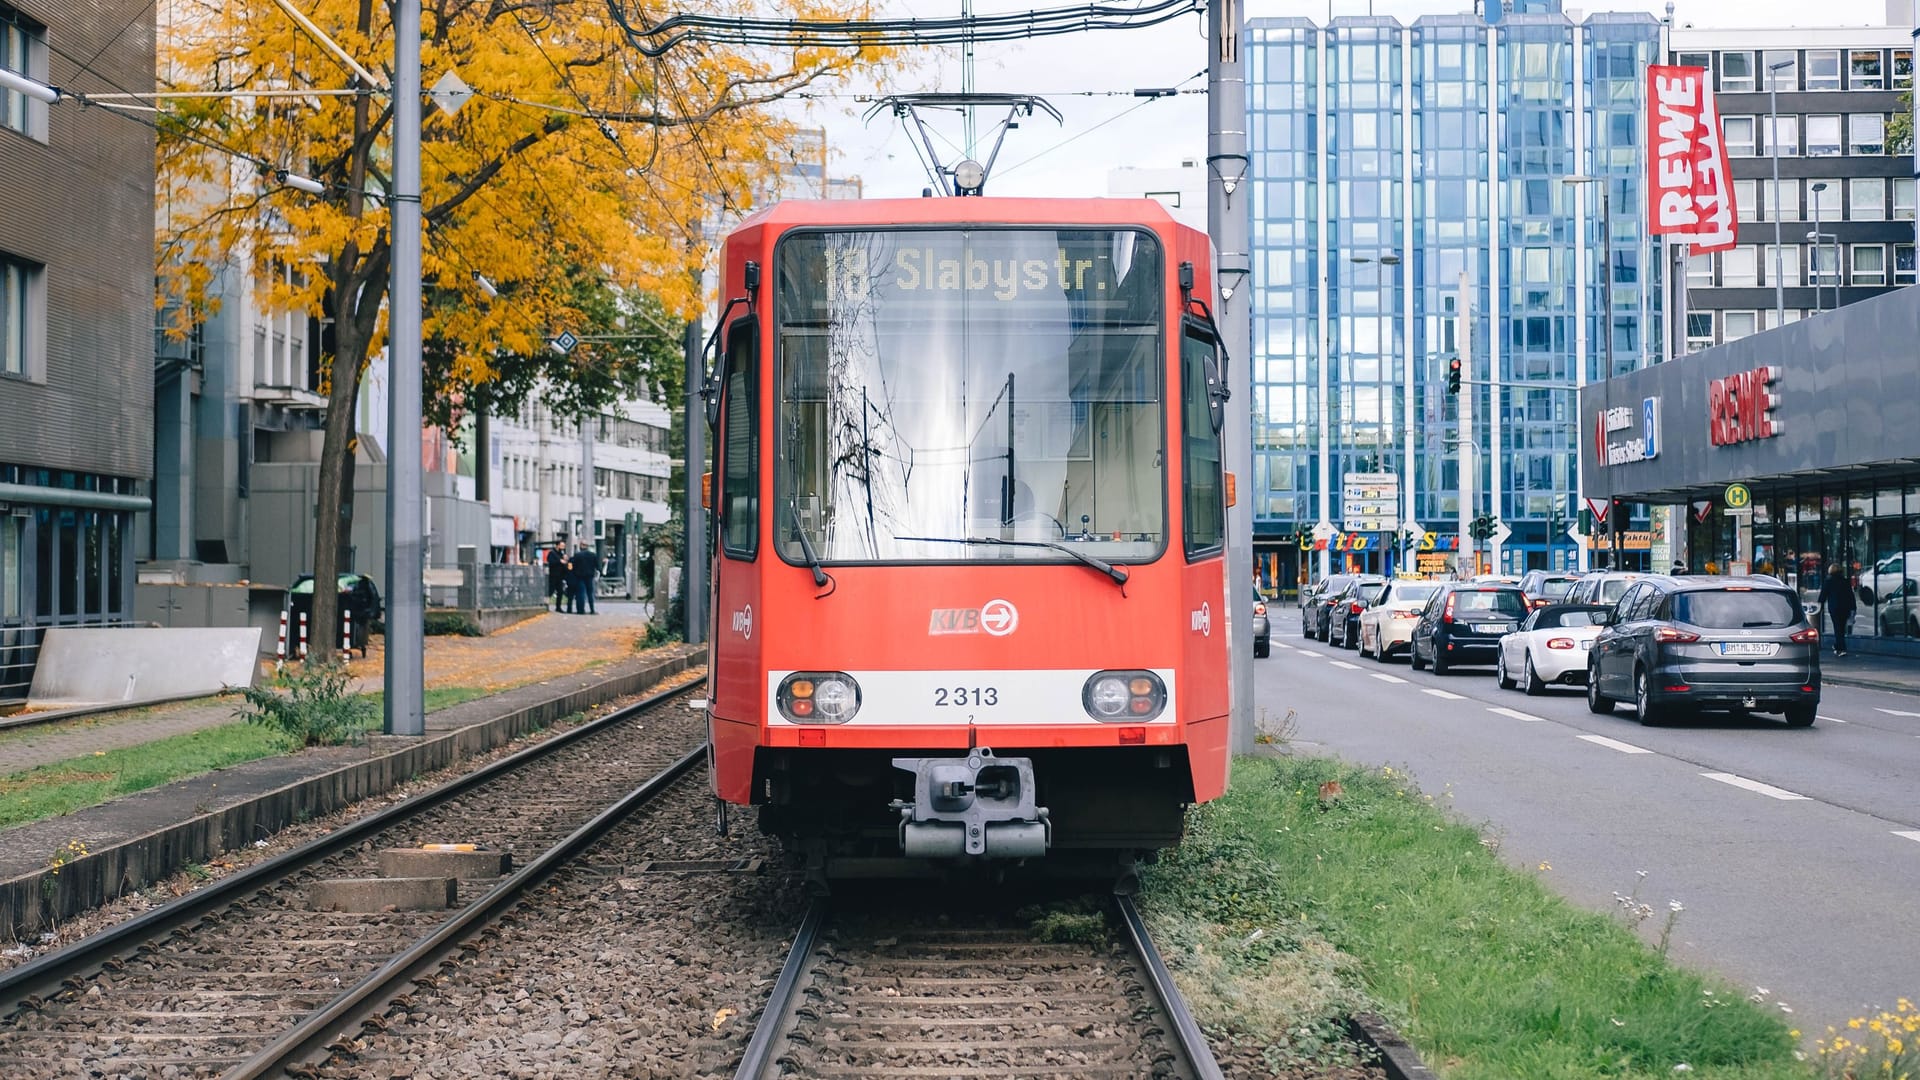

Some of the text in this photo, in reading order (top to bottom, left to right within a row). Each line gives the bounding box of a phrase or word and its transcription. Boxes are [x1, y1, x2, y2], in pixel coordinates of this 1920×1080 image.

[1656, 75, 1699, 227] REWE
[896, 248, 1106, 300] Slabystr.
[1710, 366, 1776, 446] REWE
[931, 609, 979, 630] KVB
[1751, 643, 1770, 652] 3517
[934, 687, 998, 706] 2313
